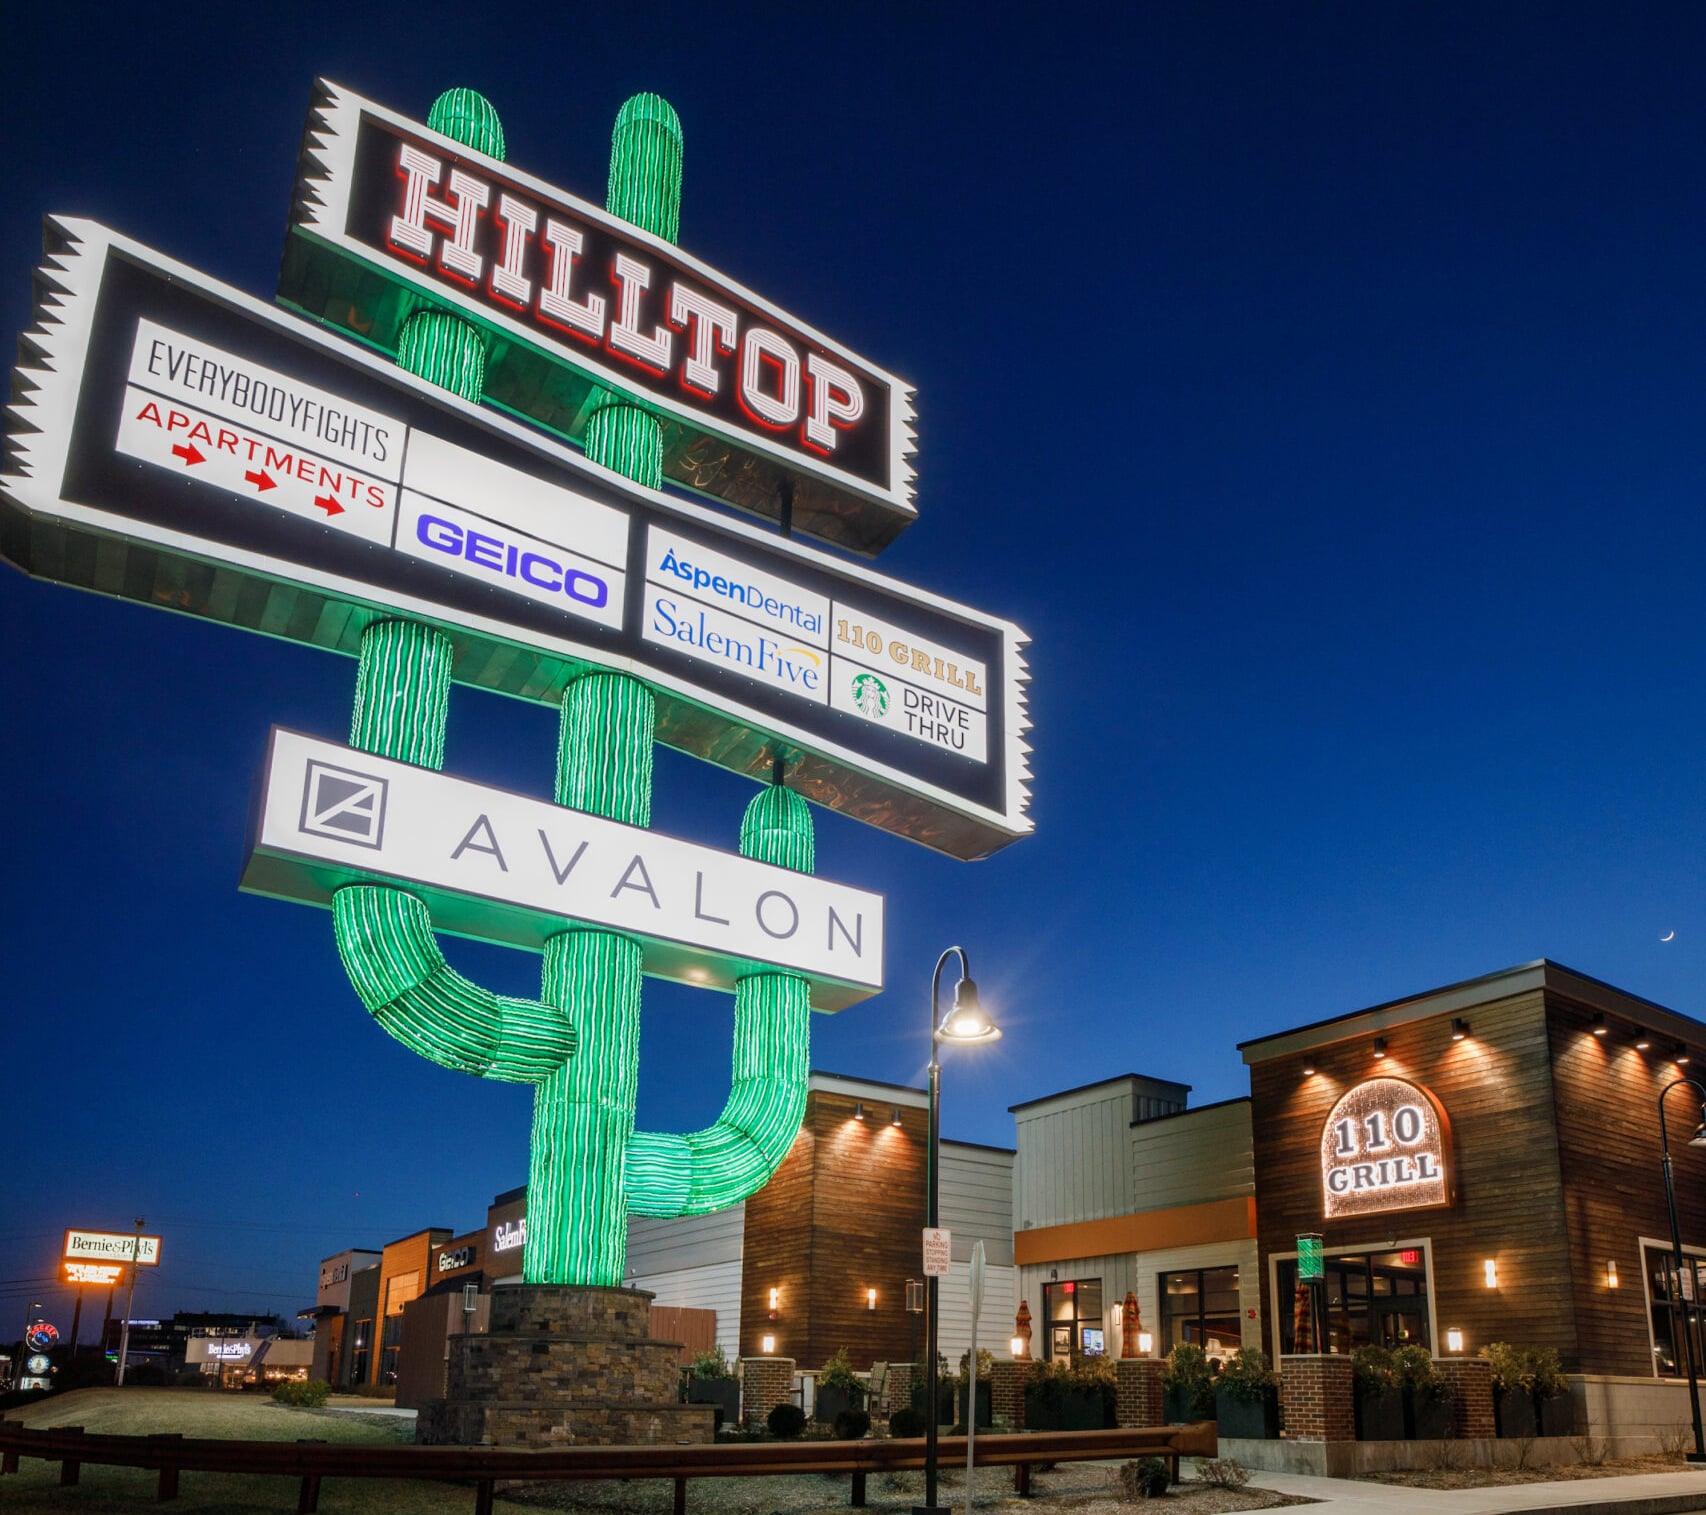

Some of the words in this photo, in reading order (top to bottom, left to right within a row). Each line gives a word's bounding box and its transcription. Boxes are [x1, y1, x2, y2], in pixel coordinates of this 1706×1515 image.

[389, 142, 864, 452] HILLTOP
[147, 339, 389, 462] EVERYBODYFIGHTS
[135, 402, 385, 508] APARTMENTS
[416, 513, 608, 609] GEICO
[837, 619, 883, 655] 110
[888, 641, 982, 696] GRILL
[903, 687, 970, 731] DRIVE
[903, 710, 965, 750] THRU
[450, 813, 863, 958] AVALON
[1336, 1107, 1421, 1154] 110
[1328, 1154, 1438, 1192] GRILL
[925, 1240, 948, 1249] PARKING
